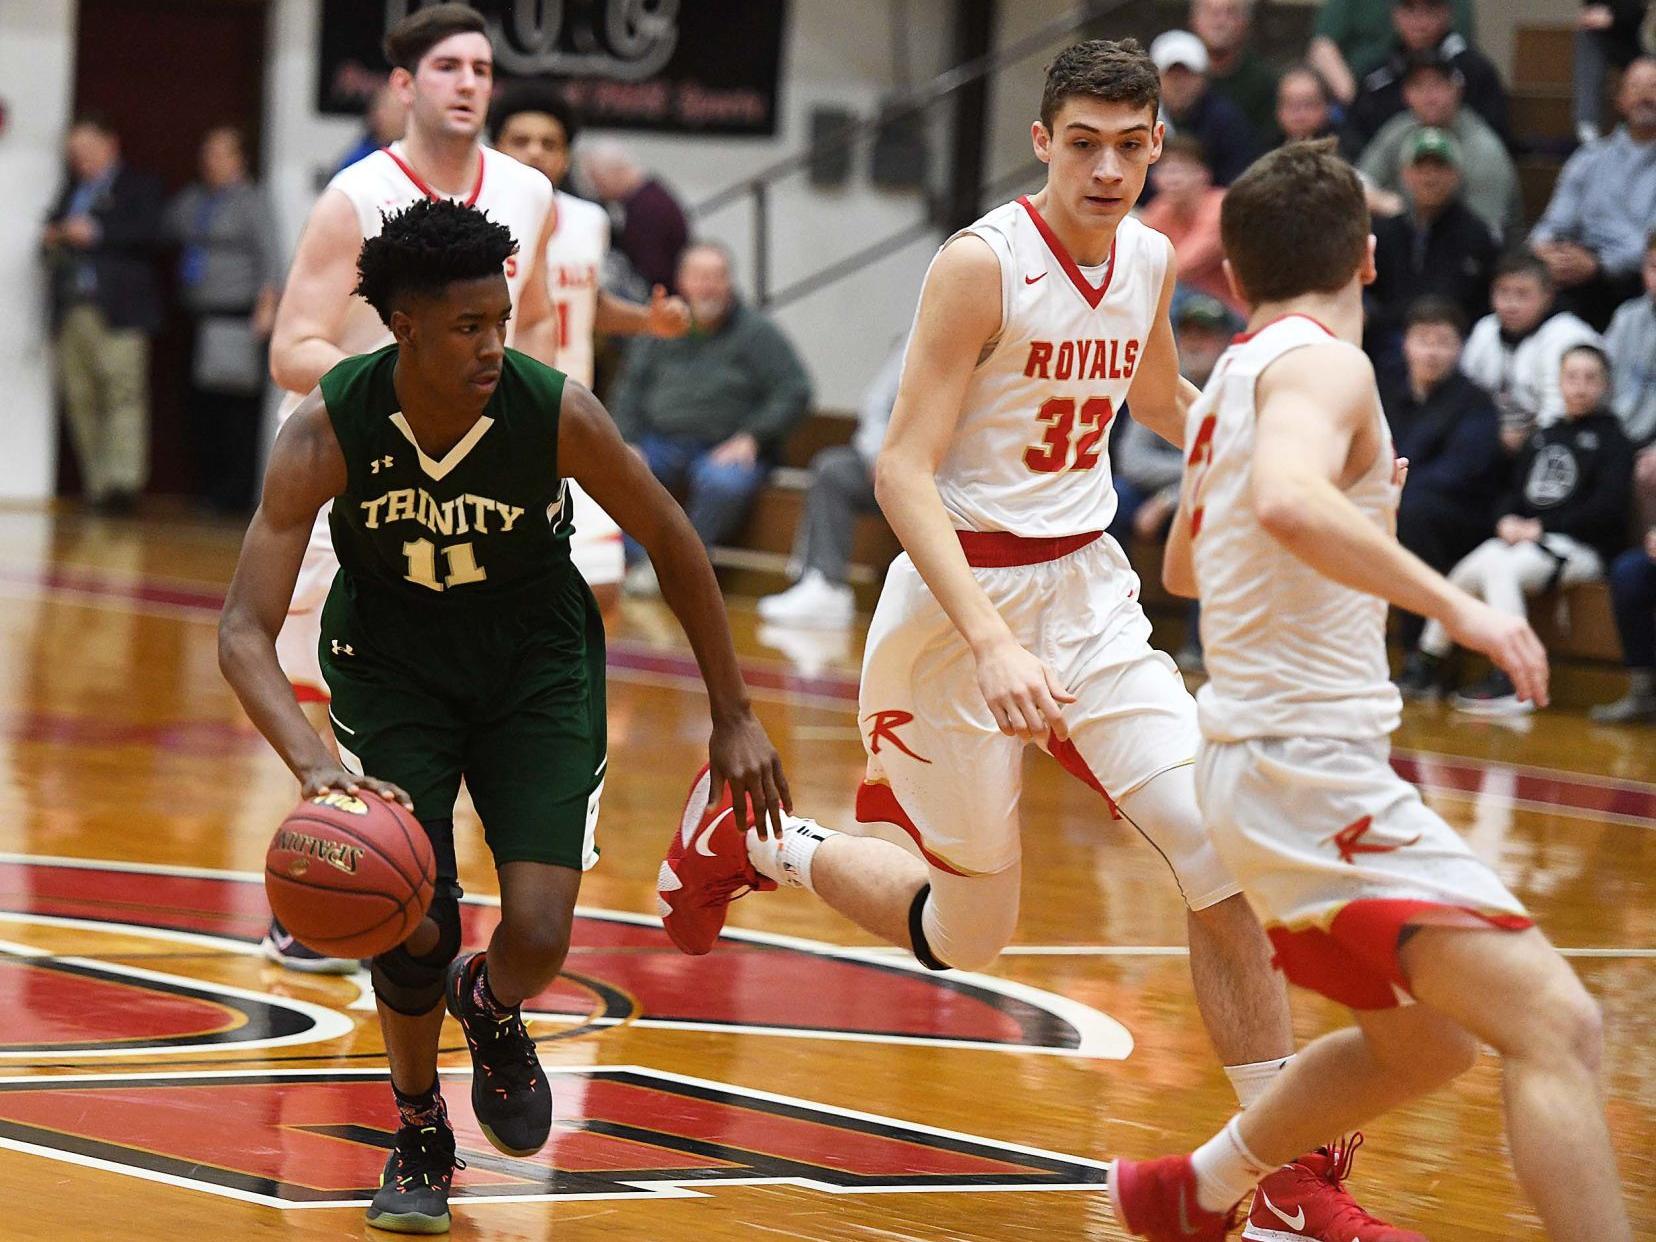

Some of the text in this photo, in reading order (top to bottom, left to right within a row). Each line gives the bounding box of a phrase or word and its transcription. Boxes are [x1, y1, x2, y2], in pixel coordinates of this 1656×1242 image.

[1023, 339, 1140, 381] ROYALS
[1022, 396, 1114, 475] 32
[360, 487, 525, 536] TRINITY
[402, 537, 488, 592] 11
[276, 830, 365, 876] SPALDIN
